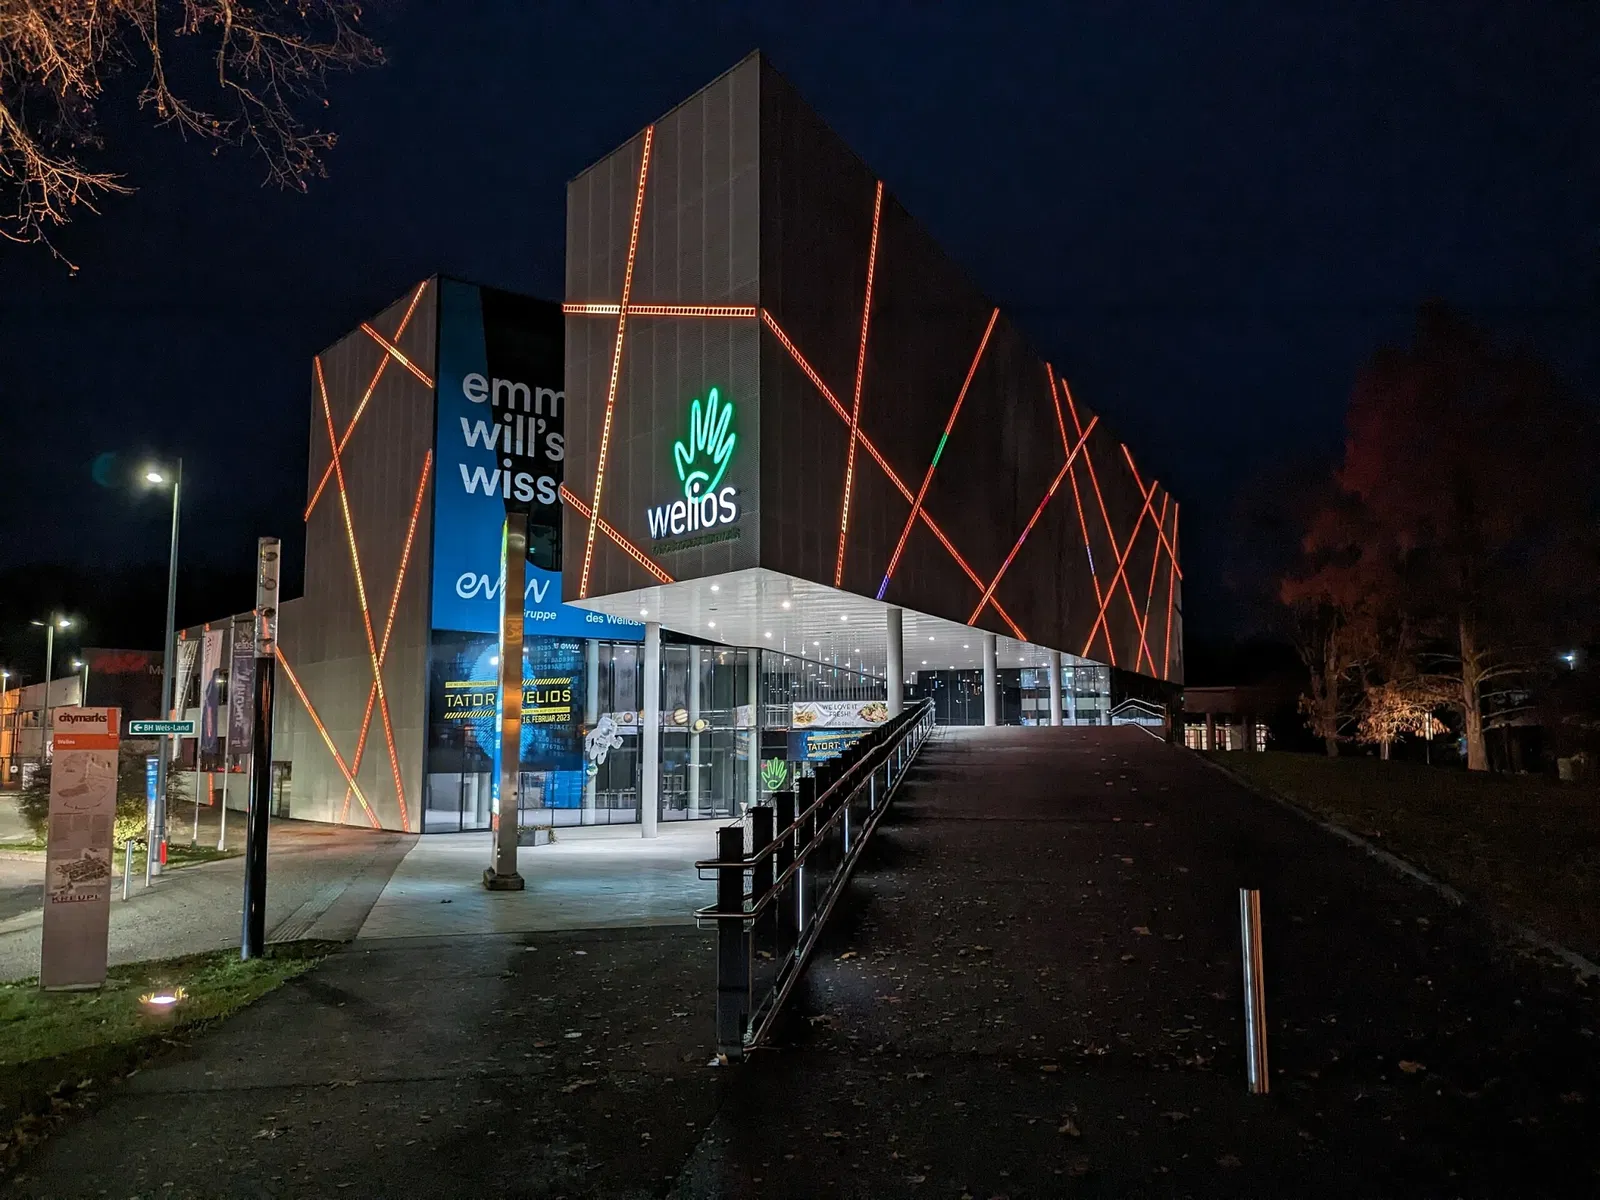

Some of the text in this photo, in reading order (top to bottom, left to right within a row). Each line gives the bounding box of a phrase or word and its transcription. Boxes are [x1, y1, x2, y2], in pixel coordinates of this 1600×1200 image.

[459, 458, 564, 505] wiss
[647, 482, 737, 539] welios
[586, 612, 604, 624] des
[444, 693, 497, 708] TATOR
[522, 690, 571, 704] ELIOS
[59, 712, 108, 725] citymarks
[532, 714, 556, 723] FEBRUAR
[557, 713, 571, 722] 2023
[155, 724, 190, 732] Wels-Land
[807, 740, 860, 751] TATORT: WE
